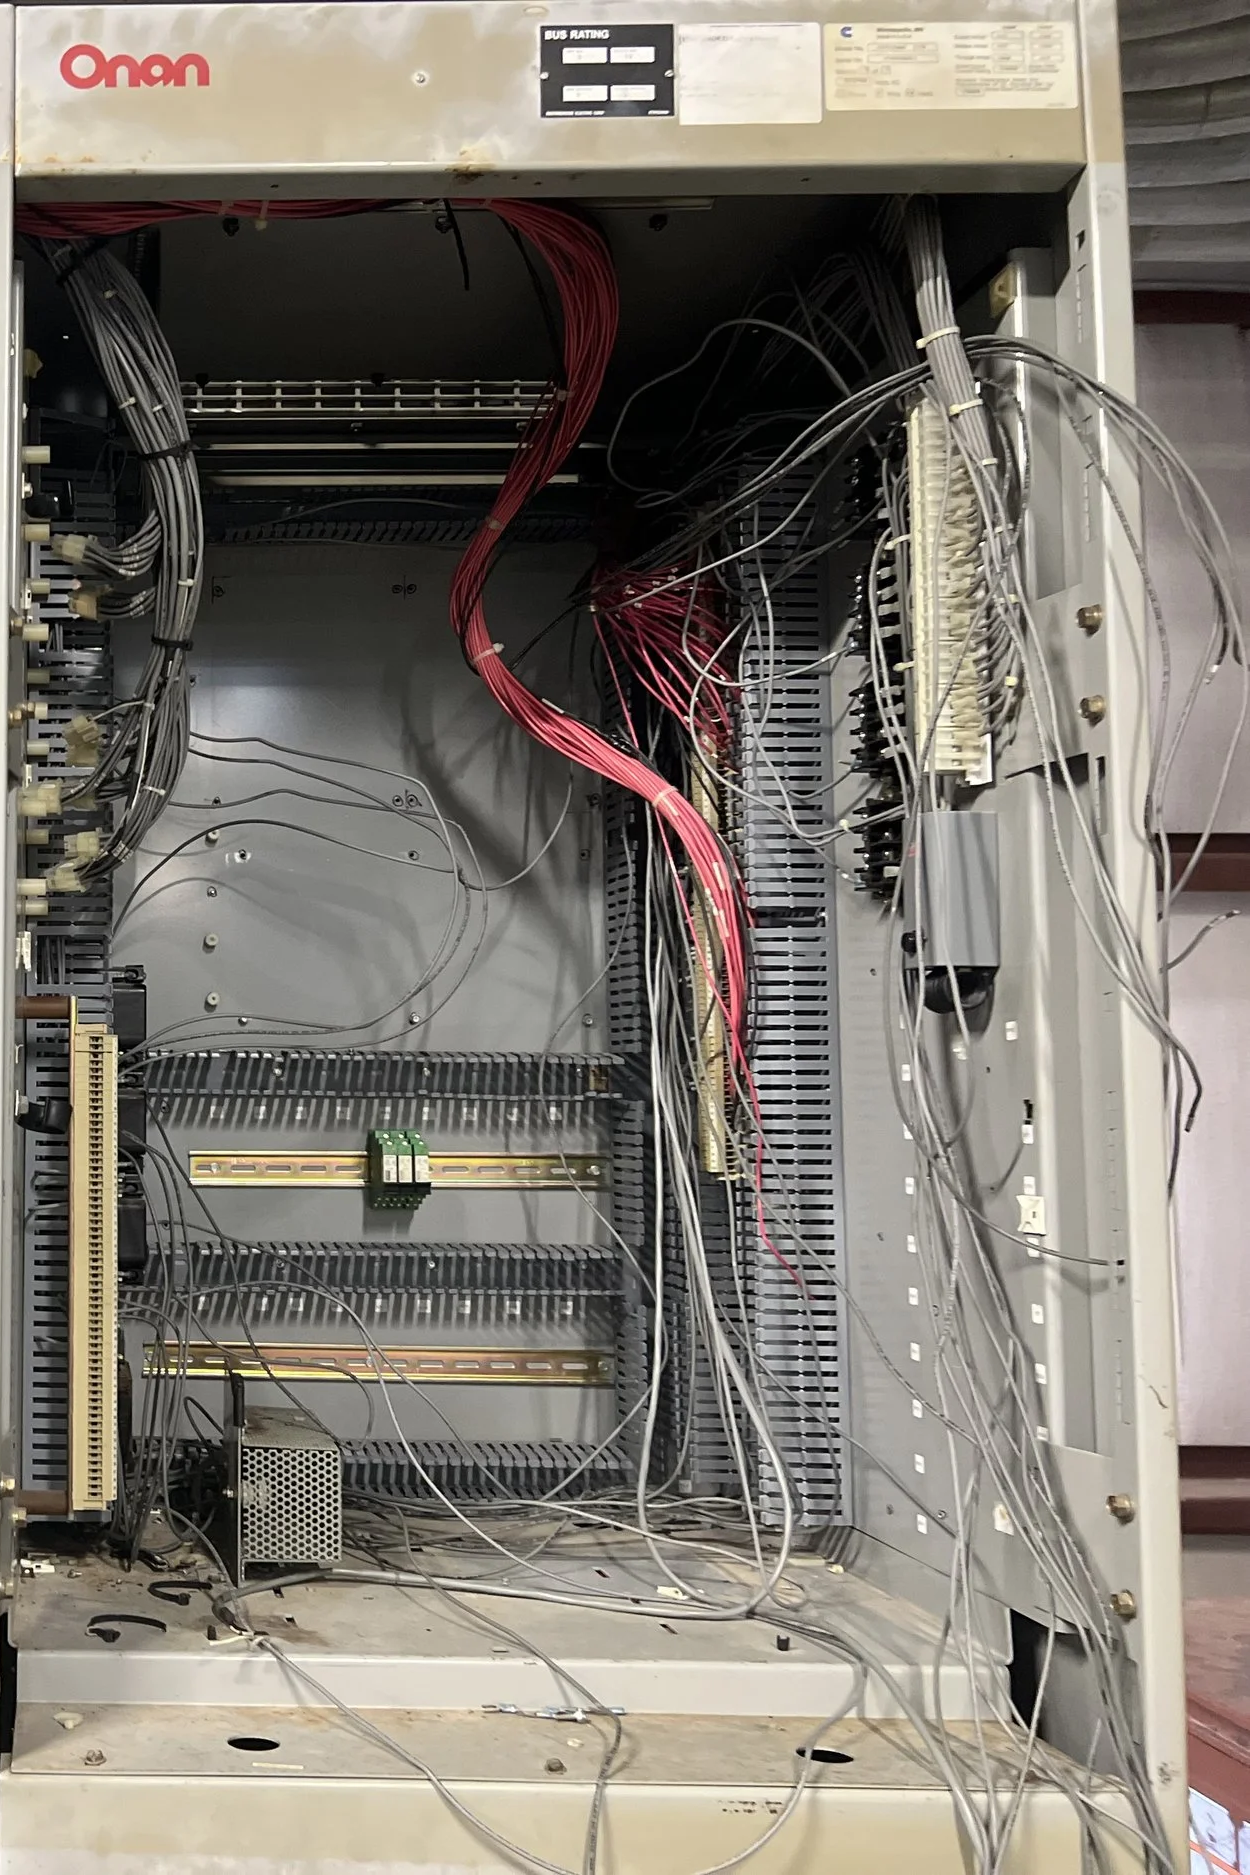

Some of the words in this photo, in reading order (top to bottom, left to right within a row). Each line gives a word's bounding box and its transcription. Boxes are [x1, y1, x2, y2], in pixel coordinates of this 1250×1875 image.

[544, 30, 568, 40] BUS
[570, 29, 610, 39] RATING
[60, 44, 210, 89] Onan
